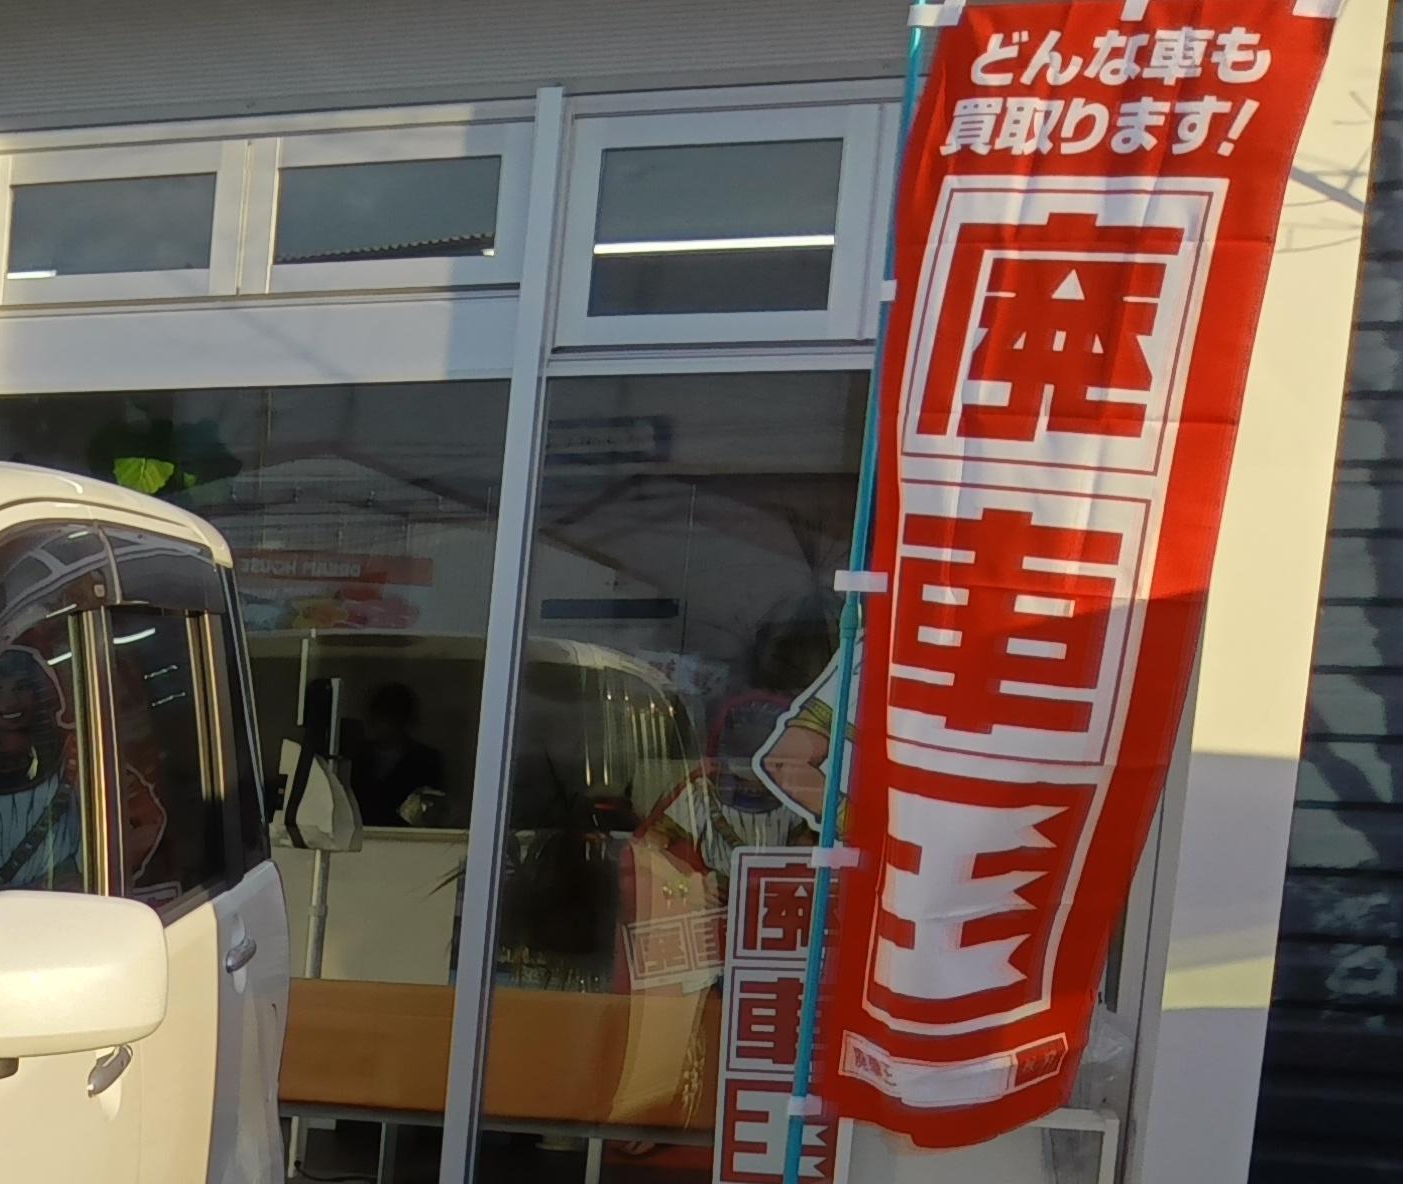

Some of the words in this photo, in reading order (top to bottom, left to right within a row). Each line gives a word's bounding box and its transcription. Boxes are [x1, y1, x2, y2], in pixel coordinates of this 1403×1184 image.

[970, 27, 1272, 87] どんな車も
[939, 97, 1260, 158] 買取ります!
